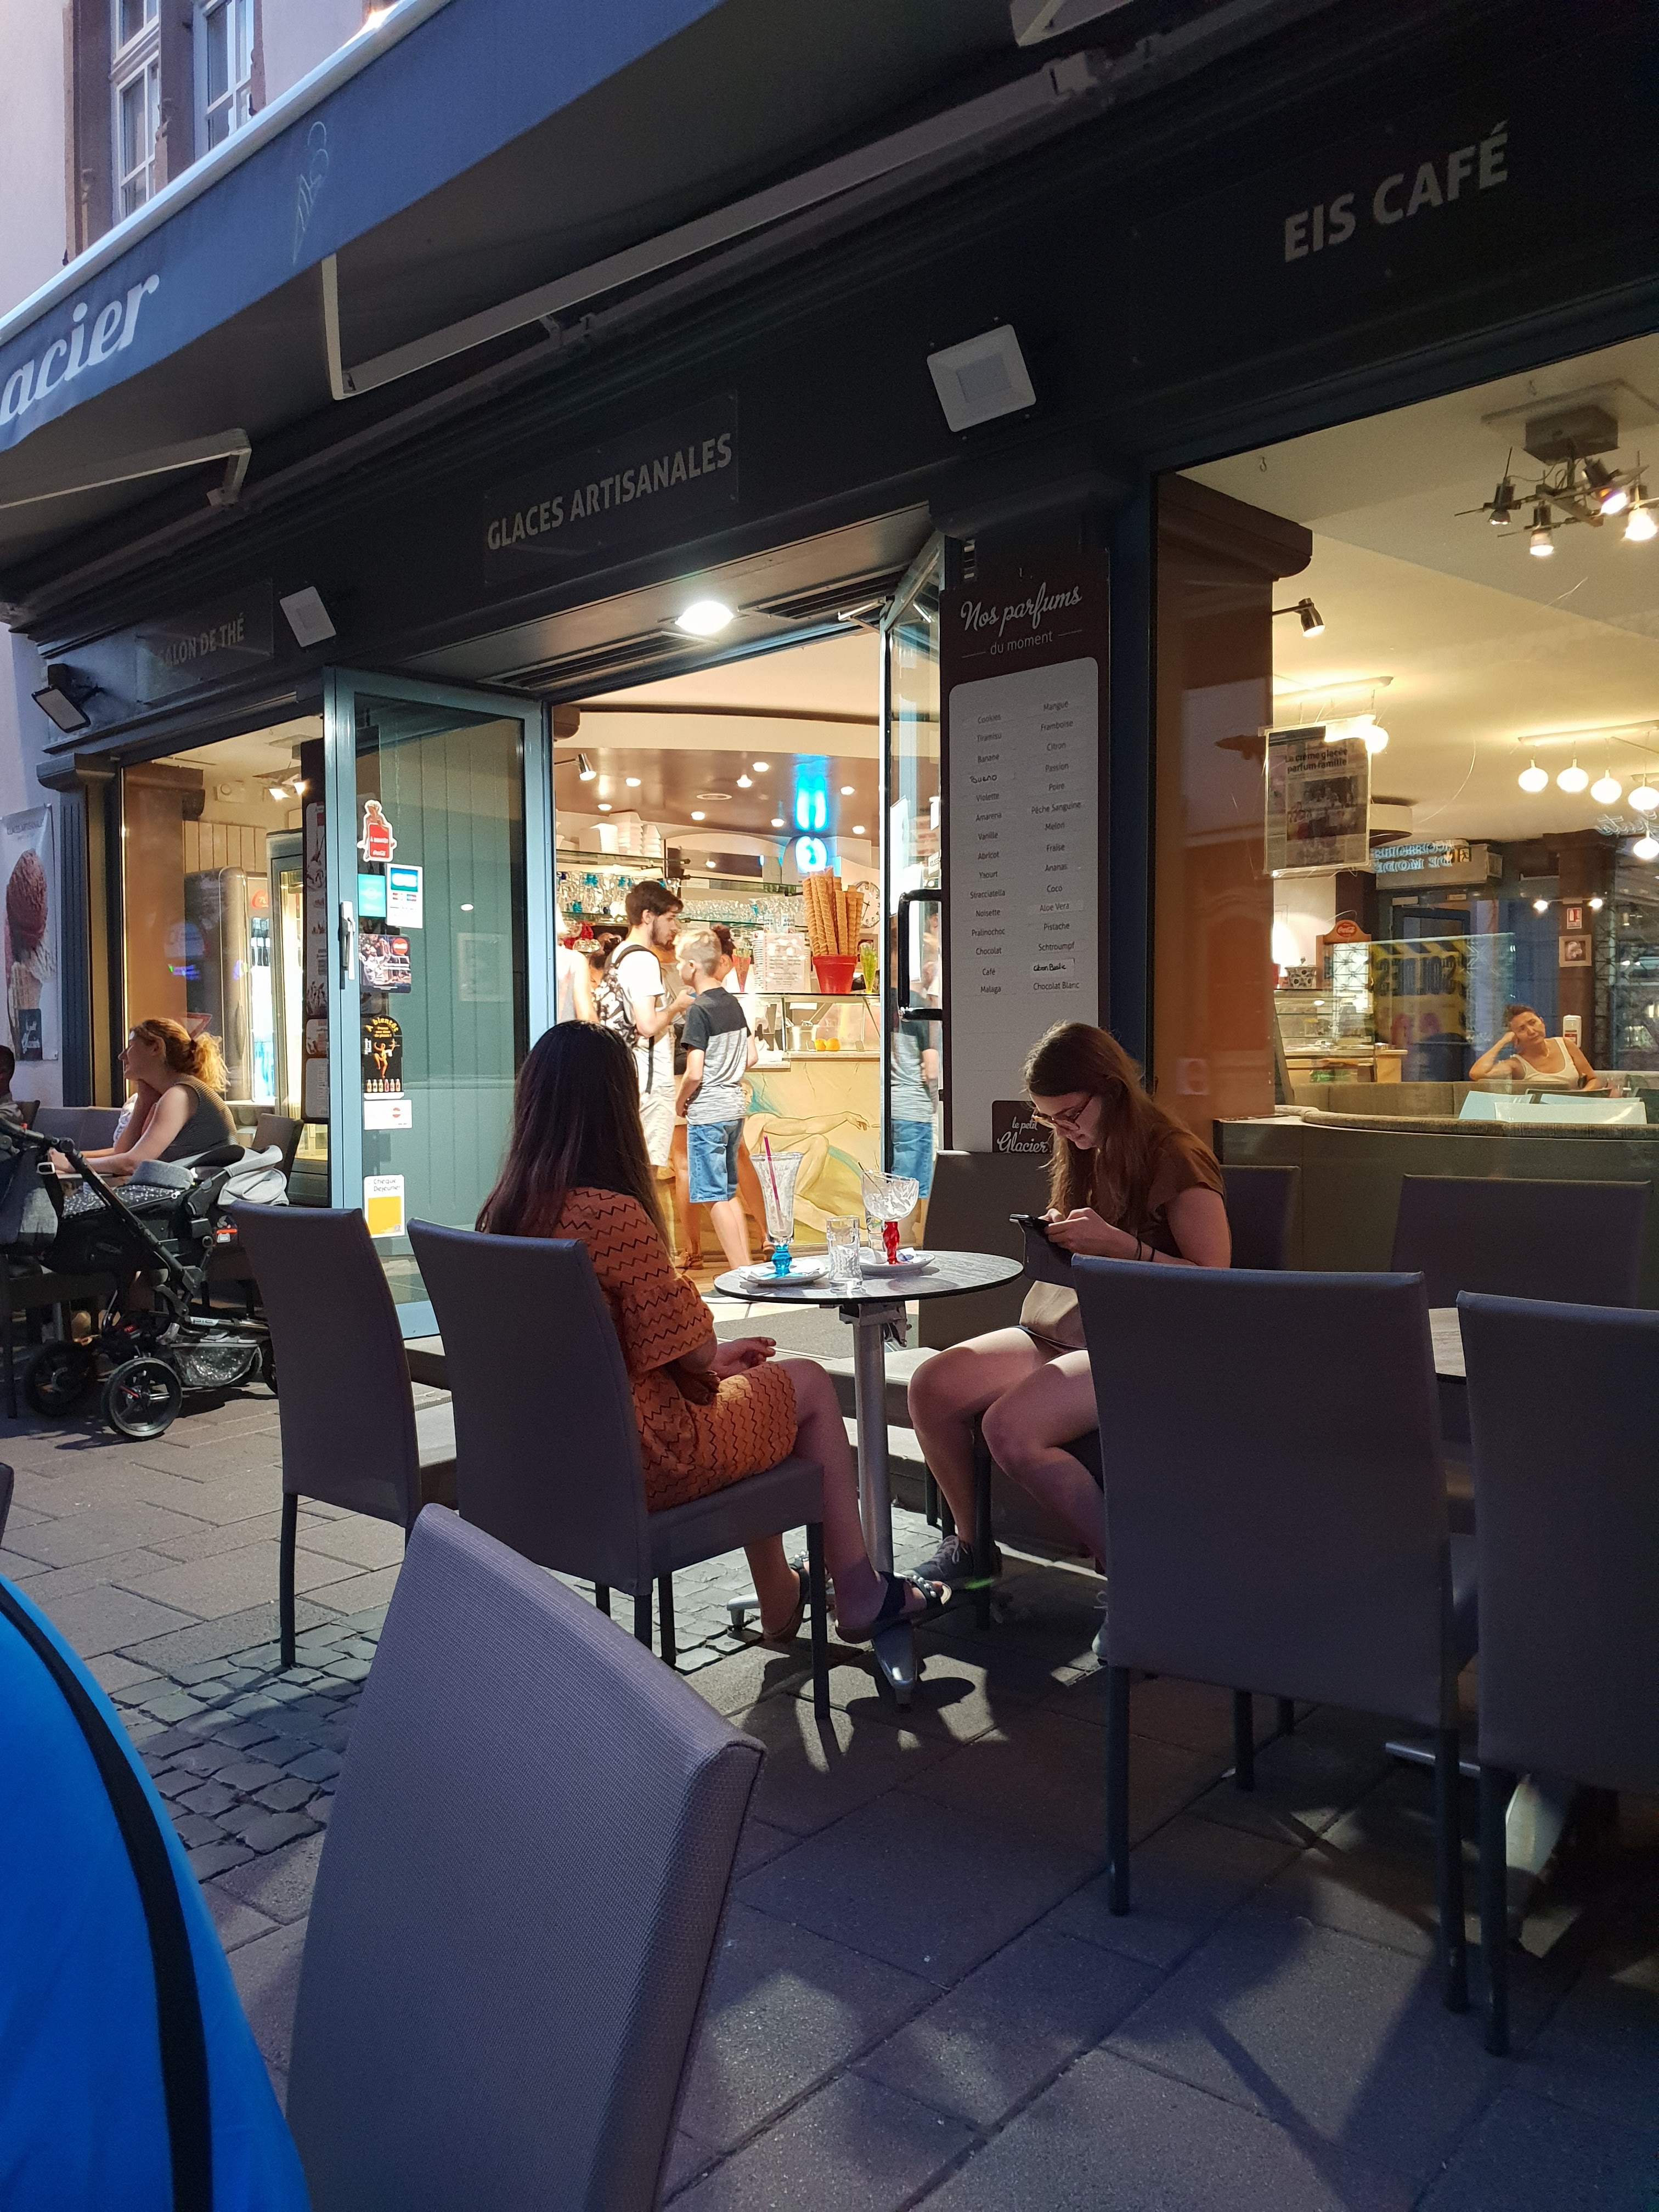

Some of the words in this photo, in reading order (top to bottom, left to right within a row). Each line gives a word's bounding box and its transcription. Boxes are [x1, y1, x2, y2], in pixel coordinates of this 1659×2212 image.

[1284, 192, 1356, 263] EIS
[1373, 117, 1510, 224] CAFÉ
[487, 495, 564, 550] GLACES
[569, 432, 732, 521] ARTISANALES
[960, 600, 999, 631] Nos
[997, 582, 1082, 637] parfums
[165, 636, 196, 667] ALON
[200, 628, 217, 656] DE
[219, 612, 245, 648] THÉ
[990, 640, 1005, 655] du
[1007, 631, 1053, 652] moment
[1043, 700, 1069, 712] Mangue
[977, 714, 1001, 724] Cookies
[1040, 720, 1074, 732] Framboise
[977, 733, 1002, 743] Tiramisu
[1046, 742, 1066, 752] Citron
[977, 754, 1000, 764] Banane
[1045, 763, 1069, 773] Passion
[969, 774, 997, 784] Bueno
[1048, 782, 1065, 791] Poire
[976, 792, 1000, 802] Violette
[1031, 805, 1050, 815] Pêche
[1051, 801, 1081, 812] Sanguine
[975, 812, 1002, 822] Amarena
[1045, 822, 1065, 831] Melon
[978, 831, 998, 840] Vanille
[1046, 843, 1065, 853] Fraise
[978, 851, 1000, 860] Abricot
[1045, 864, 1068, 872] Ananas
[979, 871, 998, 879] Yaourt
[1047, 884, 1063, 893] Coco
[969, 889, 1006, 899] Stracciatella
[1055, 902, 1070, 911] Vera
[975, 909, 1001, 917] Noisette
[1043, 922, 1070, 931] Pistache
[975, 946, 1002, 956] Chocolat
[1038, 941, 1075, 952] Schtroumpf
[982, 968, 996, 977] Café
[980, 985, 1001, 994] Malaga
[1033, 982, 1060, 990] Chocolat
[1012, 1116, 1019, 1128] le
[996, 1131, 1048, 1153] Glacier
